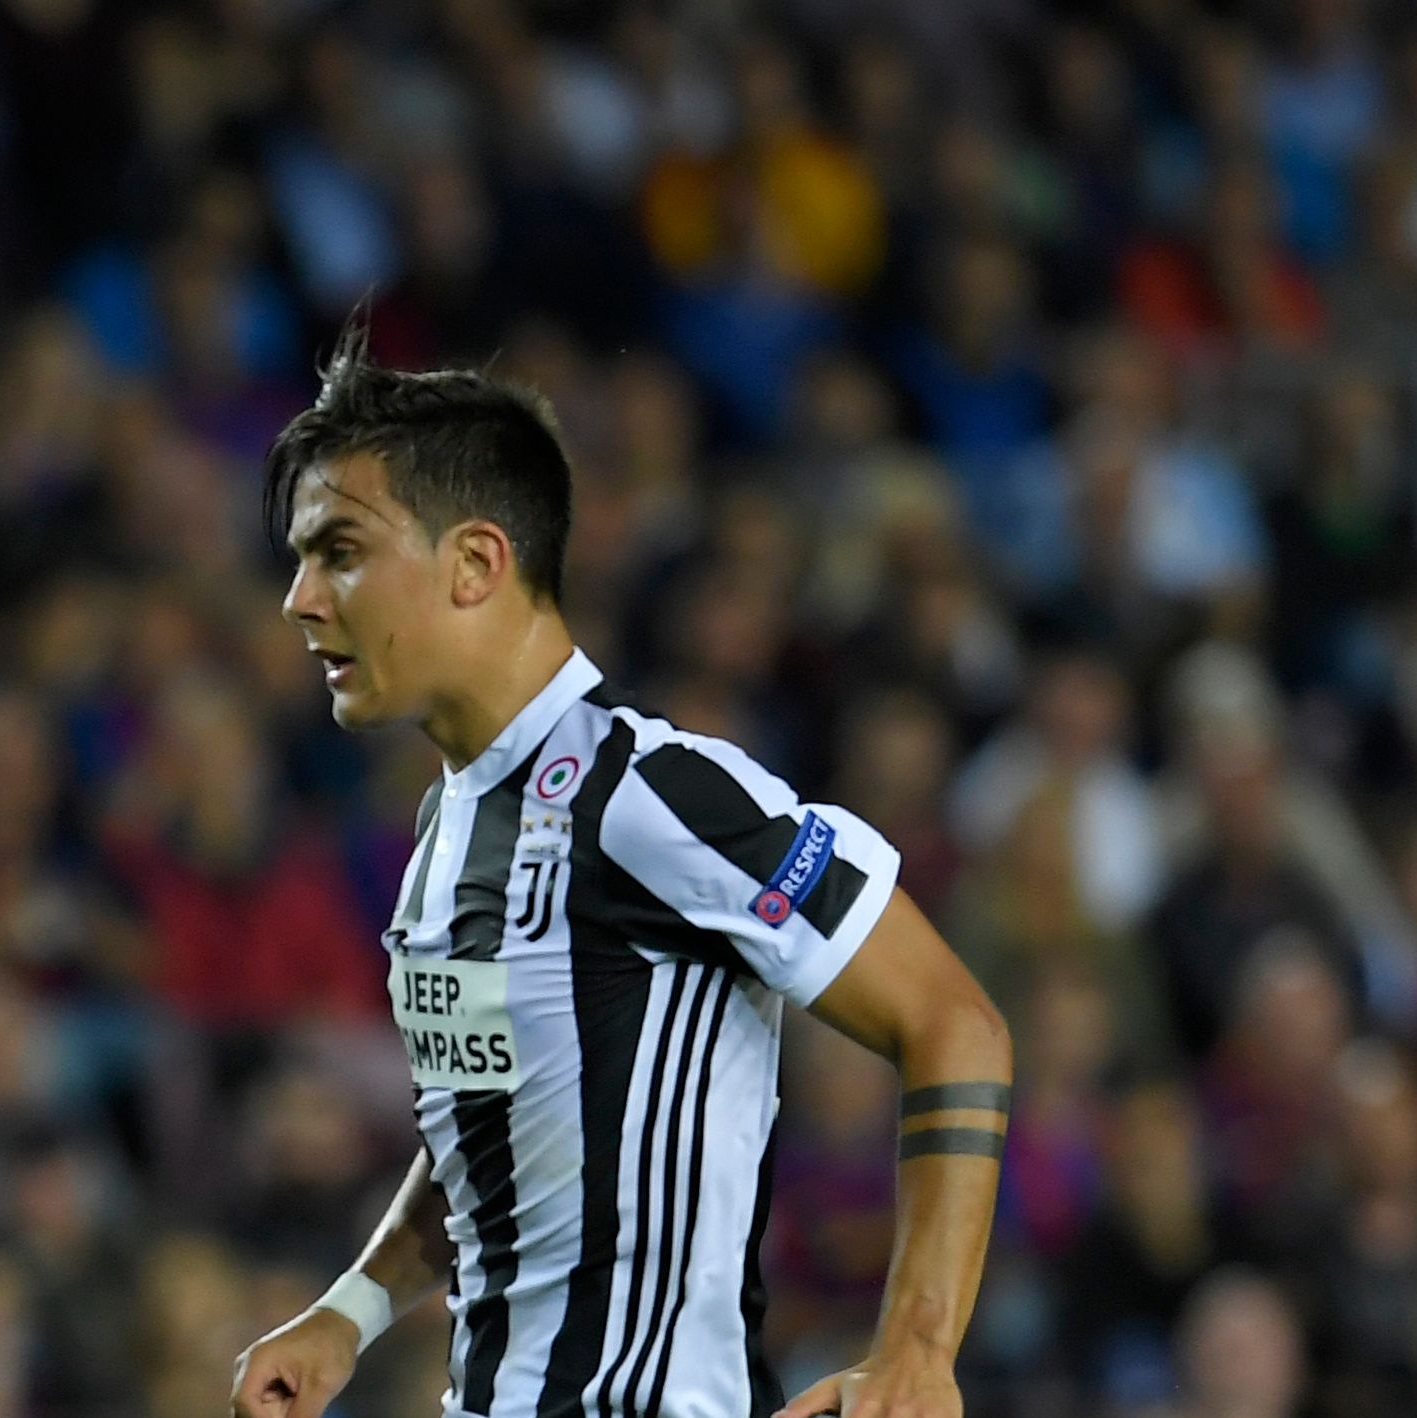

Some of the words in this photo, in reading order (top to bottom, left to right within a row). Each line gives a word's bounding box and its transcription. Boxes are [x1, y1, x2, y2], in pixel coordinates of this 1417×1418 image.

[779, 817, 829, 897] RESPECT
[403, 971, 460, 1016] JEEP
[403, 1027, 513, 1074] MPASS
